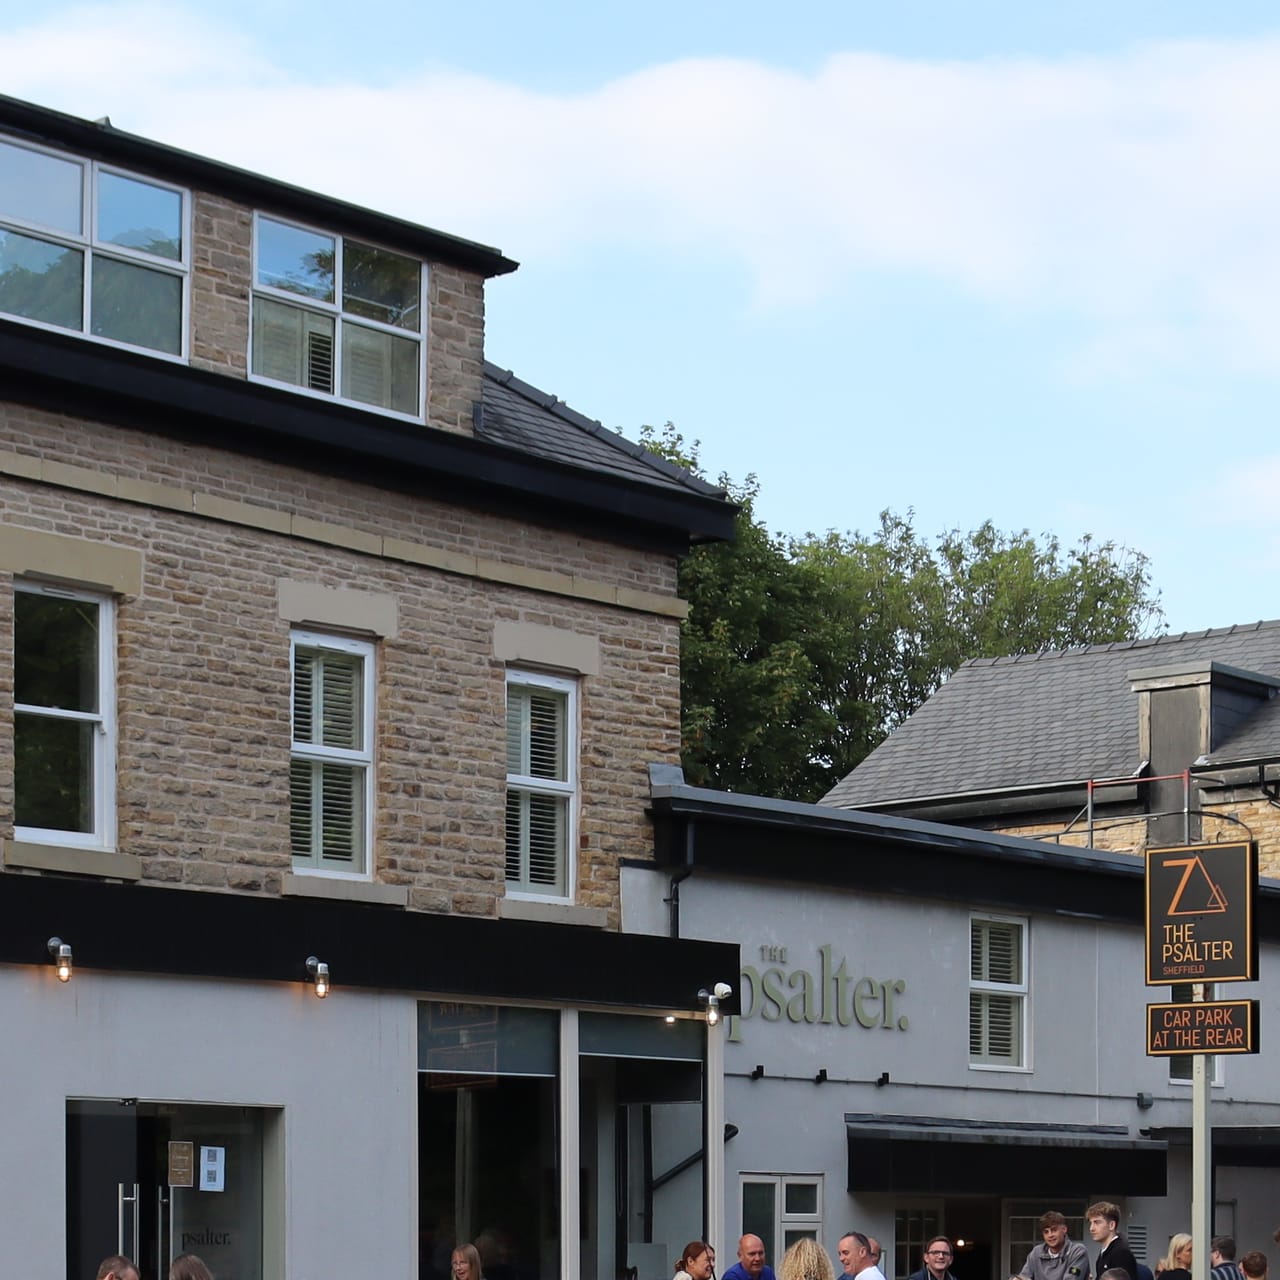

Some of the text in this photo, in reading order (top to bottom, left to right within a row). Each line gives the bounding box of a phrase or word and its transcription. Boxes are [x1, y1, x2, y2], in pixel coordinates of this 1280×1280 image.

[1163, 923, 1196, 943] THE
[759, 944, 788, 964] THE
[1162, 940, 1233, 963] PSALTER
[1163, 964, 1205, 975] SHEFFIELD
[1164, 1008, 1233, 1028] CAR PARK
[1153, 1027, 1243, 1047] AT THE REAR
[182, 1228, 231, 1251] psalter.
